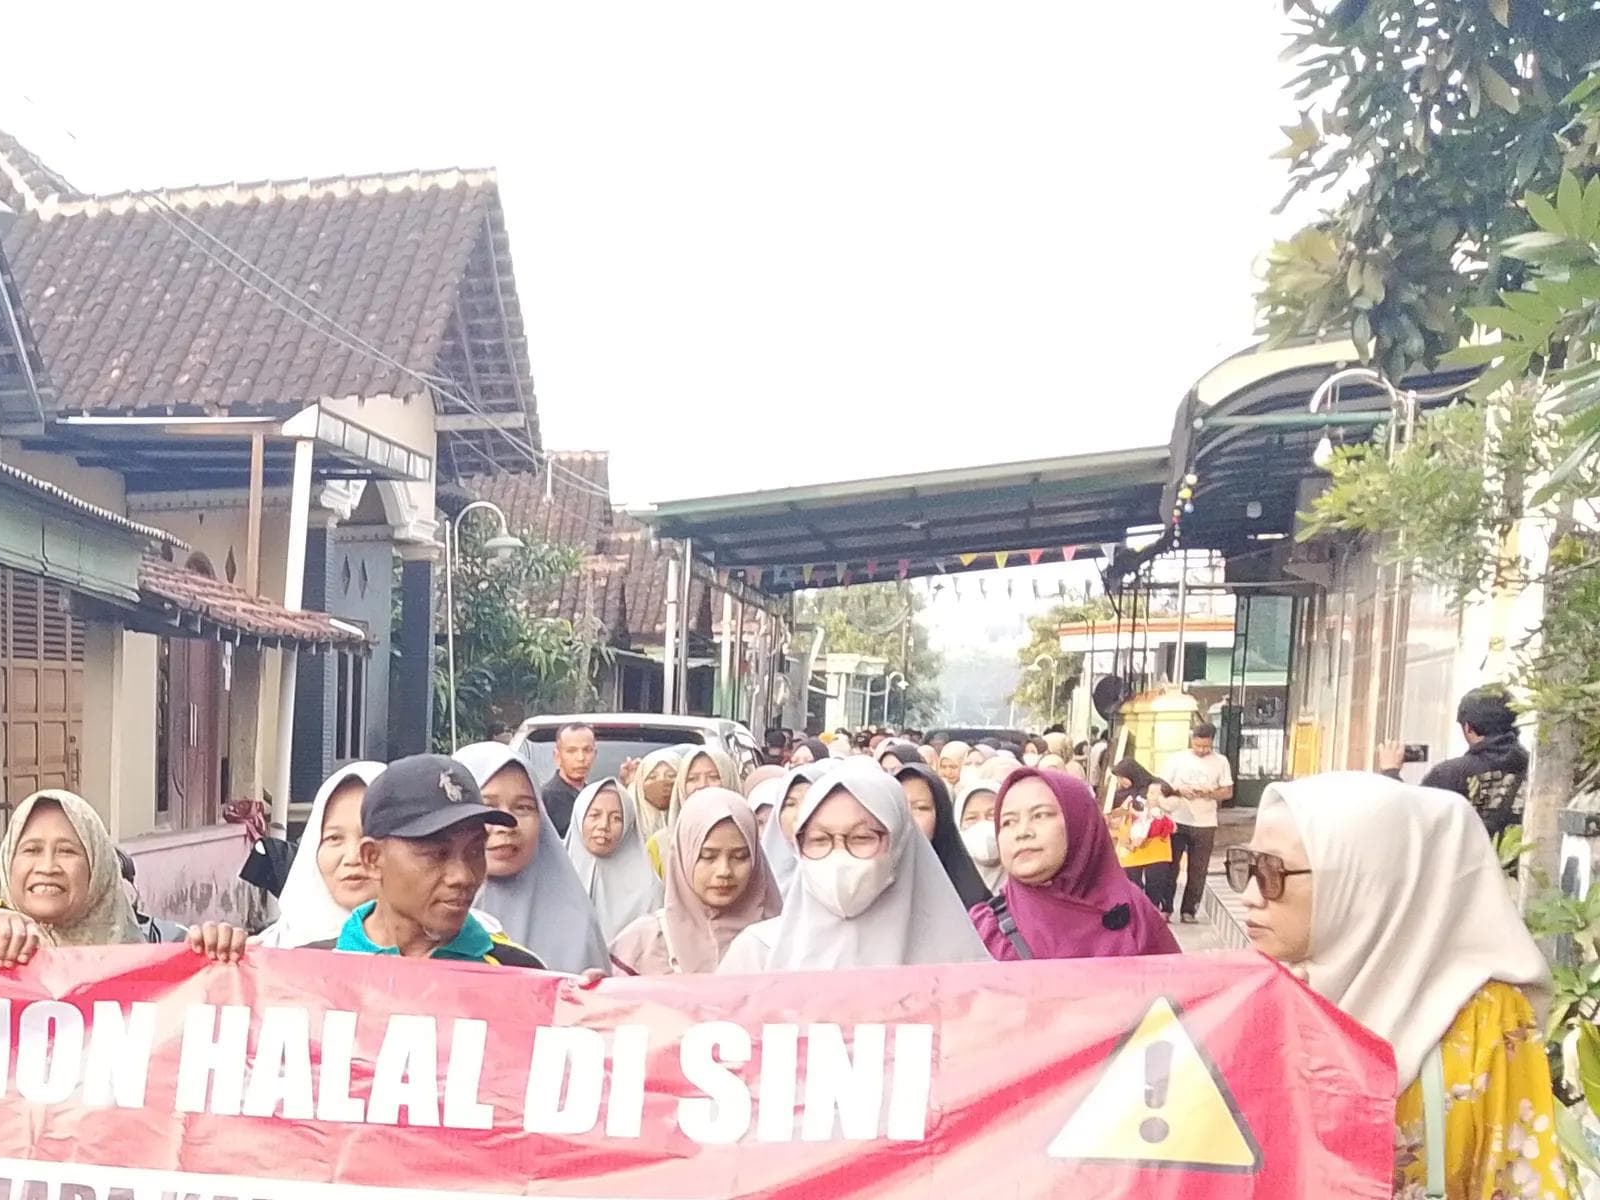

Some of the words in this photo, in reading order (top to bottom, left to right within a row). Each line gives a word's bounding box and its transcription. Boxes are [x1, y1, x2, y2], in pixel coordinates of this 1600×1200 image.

[178, 1003, 493, 1130] HALAL
[523, 1025, 649, 1139] DI
[677, 1021, 934, 1144] SINI
